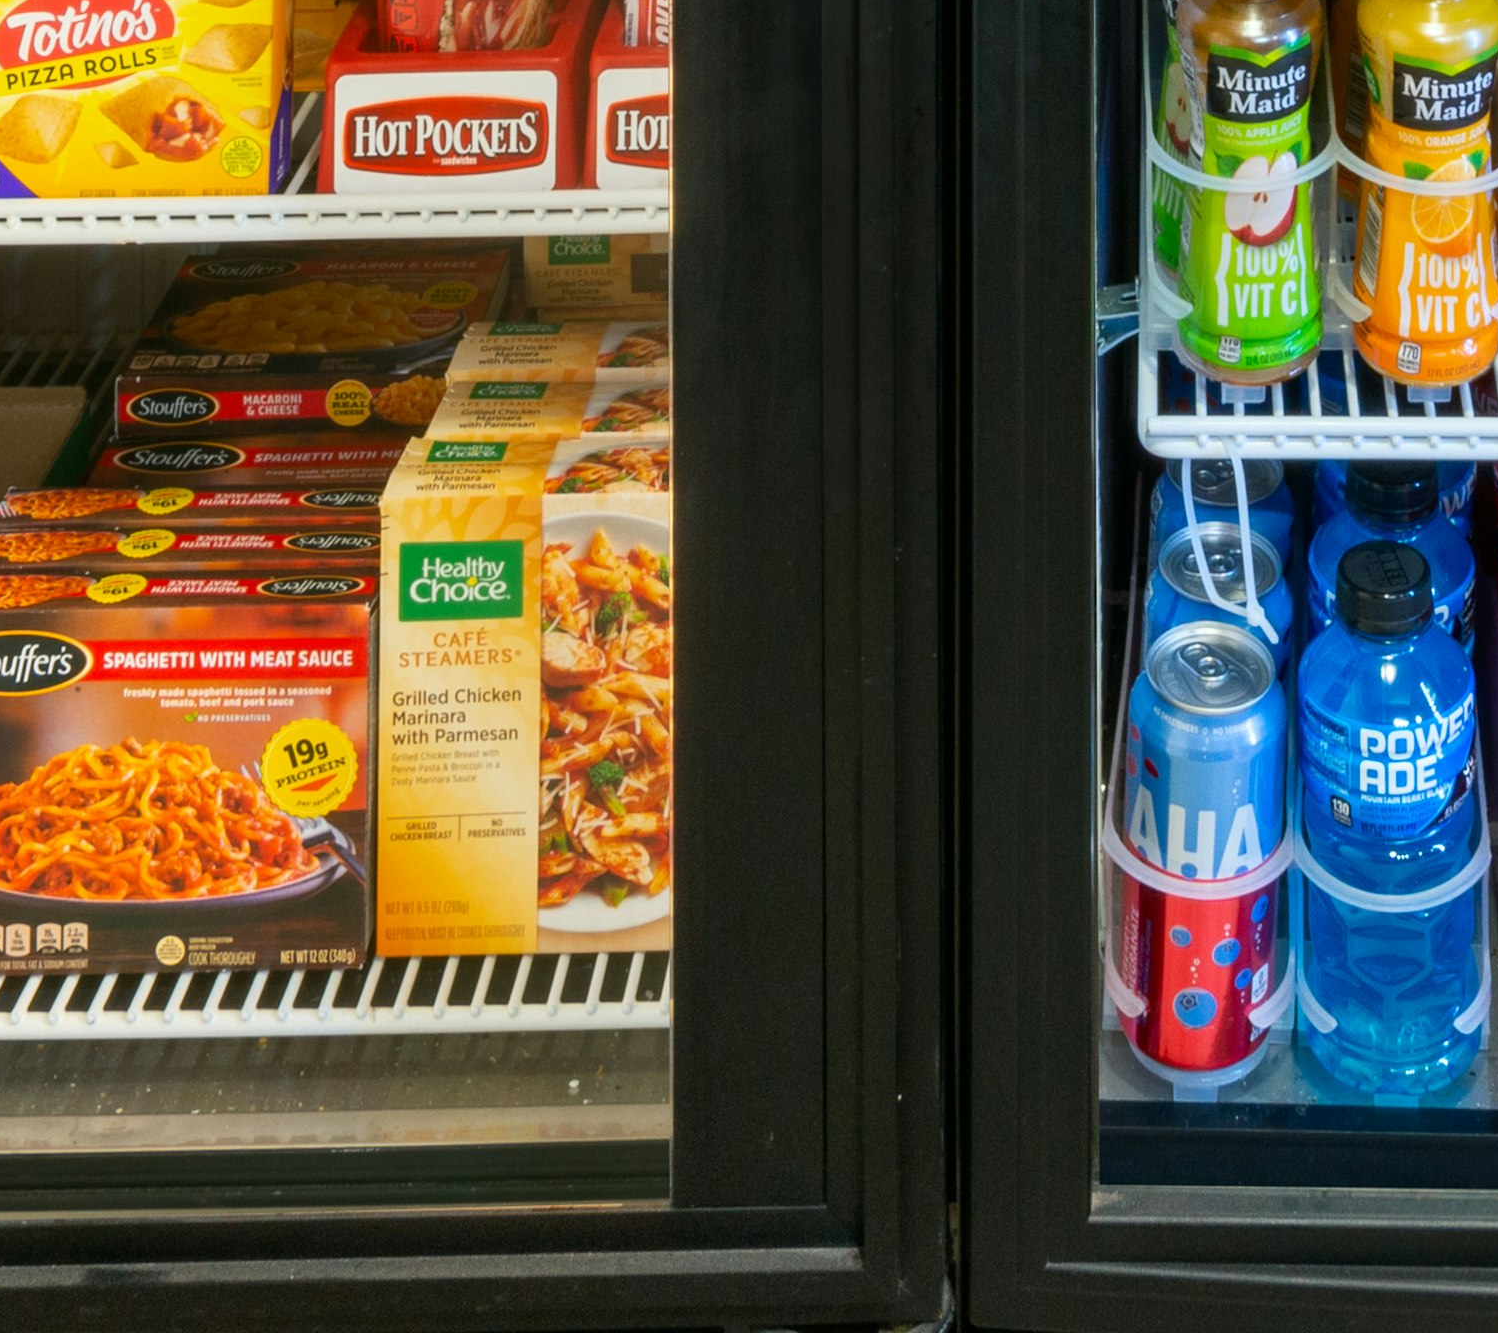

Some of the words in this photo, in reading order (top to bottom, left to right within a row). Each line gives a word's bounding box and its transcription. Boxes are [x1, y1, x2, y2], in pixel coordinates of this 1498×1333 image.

[5, 65, 79, 91] PIZZA
[84, 48, 157, 79] ROLLS
[1216, 62, 1306, 89] Minute
[1229, 88, 1300, 115] Maid
[354, 117, 413, 158] HOT
[418, 111, 538, 159] POCKETS
[1234, 245, 1300, 277] 100%
[1234, 286, 1274, 318] VIT
[1279, 283, 1297, 316] C
[134, 394, 211, 419] Stouffer's
[243, 394, 302, 405] MACARONI
[246, 405, 257, 415] &
[260, 404, 300, 415] CHEESE
[421, 557, 503, 583] Healthy
[410, 577, 510, 605] Choice
[433, 629, 488, 648] CAFÉ
[103, 651, 194, 669] SPAGHETTI
[200, 650, 246, 668] WITH
[250, 649, 295, 668] MEAT
[299, 649, 353, 667] SAUCE
[124, 687, 156, 698] freshly
[159, 687, 185, 697] made
[187, 686, 231, 698] spaghetti
[235, 686, 265, 696] tossed
[268, 686, 277, 696] in
[287, 686, 331, 696] seasoned
[160, 698, 197, 709] tomato,
[199, 697, 221, 707] beef
[223, 698, 241, 707] and
[243, 697, 264, 708] pork
[267, 699, 294, 707] sauce
[392, 690, 450, 708] Grilled
[456, 687, 521, 705] Chicken
[392, 709, 466, 727] Marinara
[392, 729, 430, 745] with
[434, 726, 518, 744] Parmesan
[282, 737, 330, 765] 19g
[274, 755, 347, 788] PROTEIN
